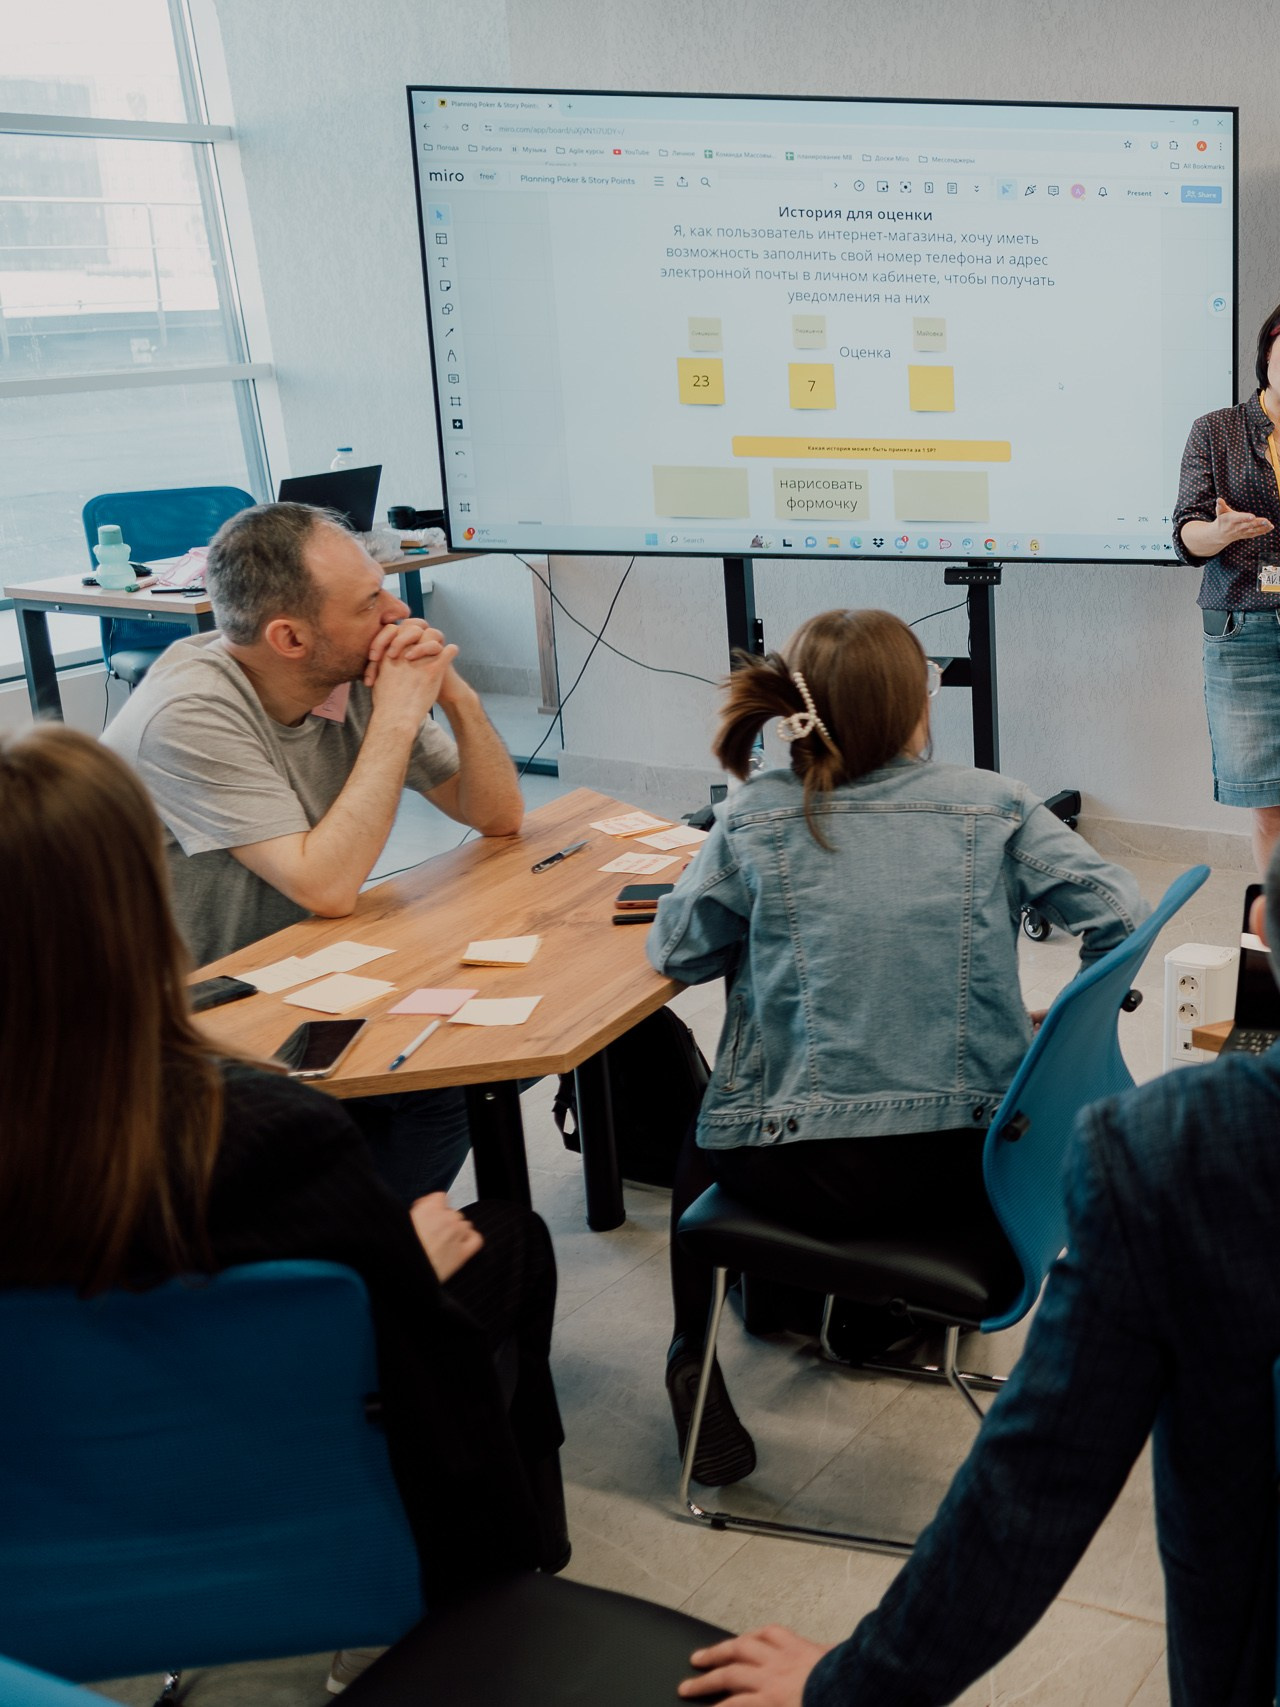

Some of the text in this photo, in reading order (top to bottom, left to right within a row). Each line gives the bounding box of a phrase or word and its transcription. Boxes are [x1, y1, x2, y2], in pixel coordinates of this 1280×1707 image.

[451, 100, 478, 109] Planning
[503, 102, 520, 110] Story
[436, 144, 460, 152] Погода
[522, 146, 547, 154] Музыка
[932, 156, 976, 164] Мессенджеры
[429, 169, 464, 182] miro
[520, 174, 636, 186] Planning Poker & Story Points
[1198, 191, 1216, 199] Share
[778, 206, 933, 222] История для оценки
[673, 224, 1039, 246] Я, как пользователь интернет-магазина, хочу иметь
[666, 248, 1049, 268] возможность заполнить свой номер телефона и адрес
[660, 266, 1055, 288] электронной почты в личном кабинете, чтобы получать
[788, 291, 930, 304] уведомления на них
[840, 346, 892, 360] Оценка
[692, 374, 710, 388] 23
[808, 380, 816, 392] 7
[780, 479, 863, 492] нарисовать
[786, 496, 858, 512] формочку
[682, 536, 704, 545] Search
